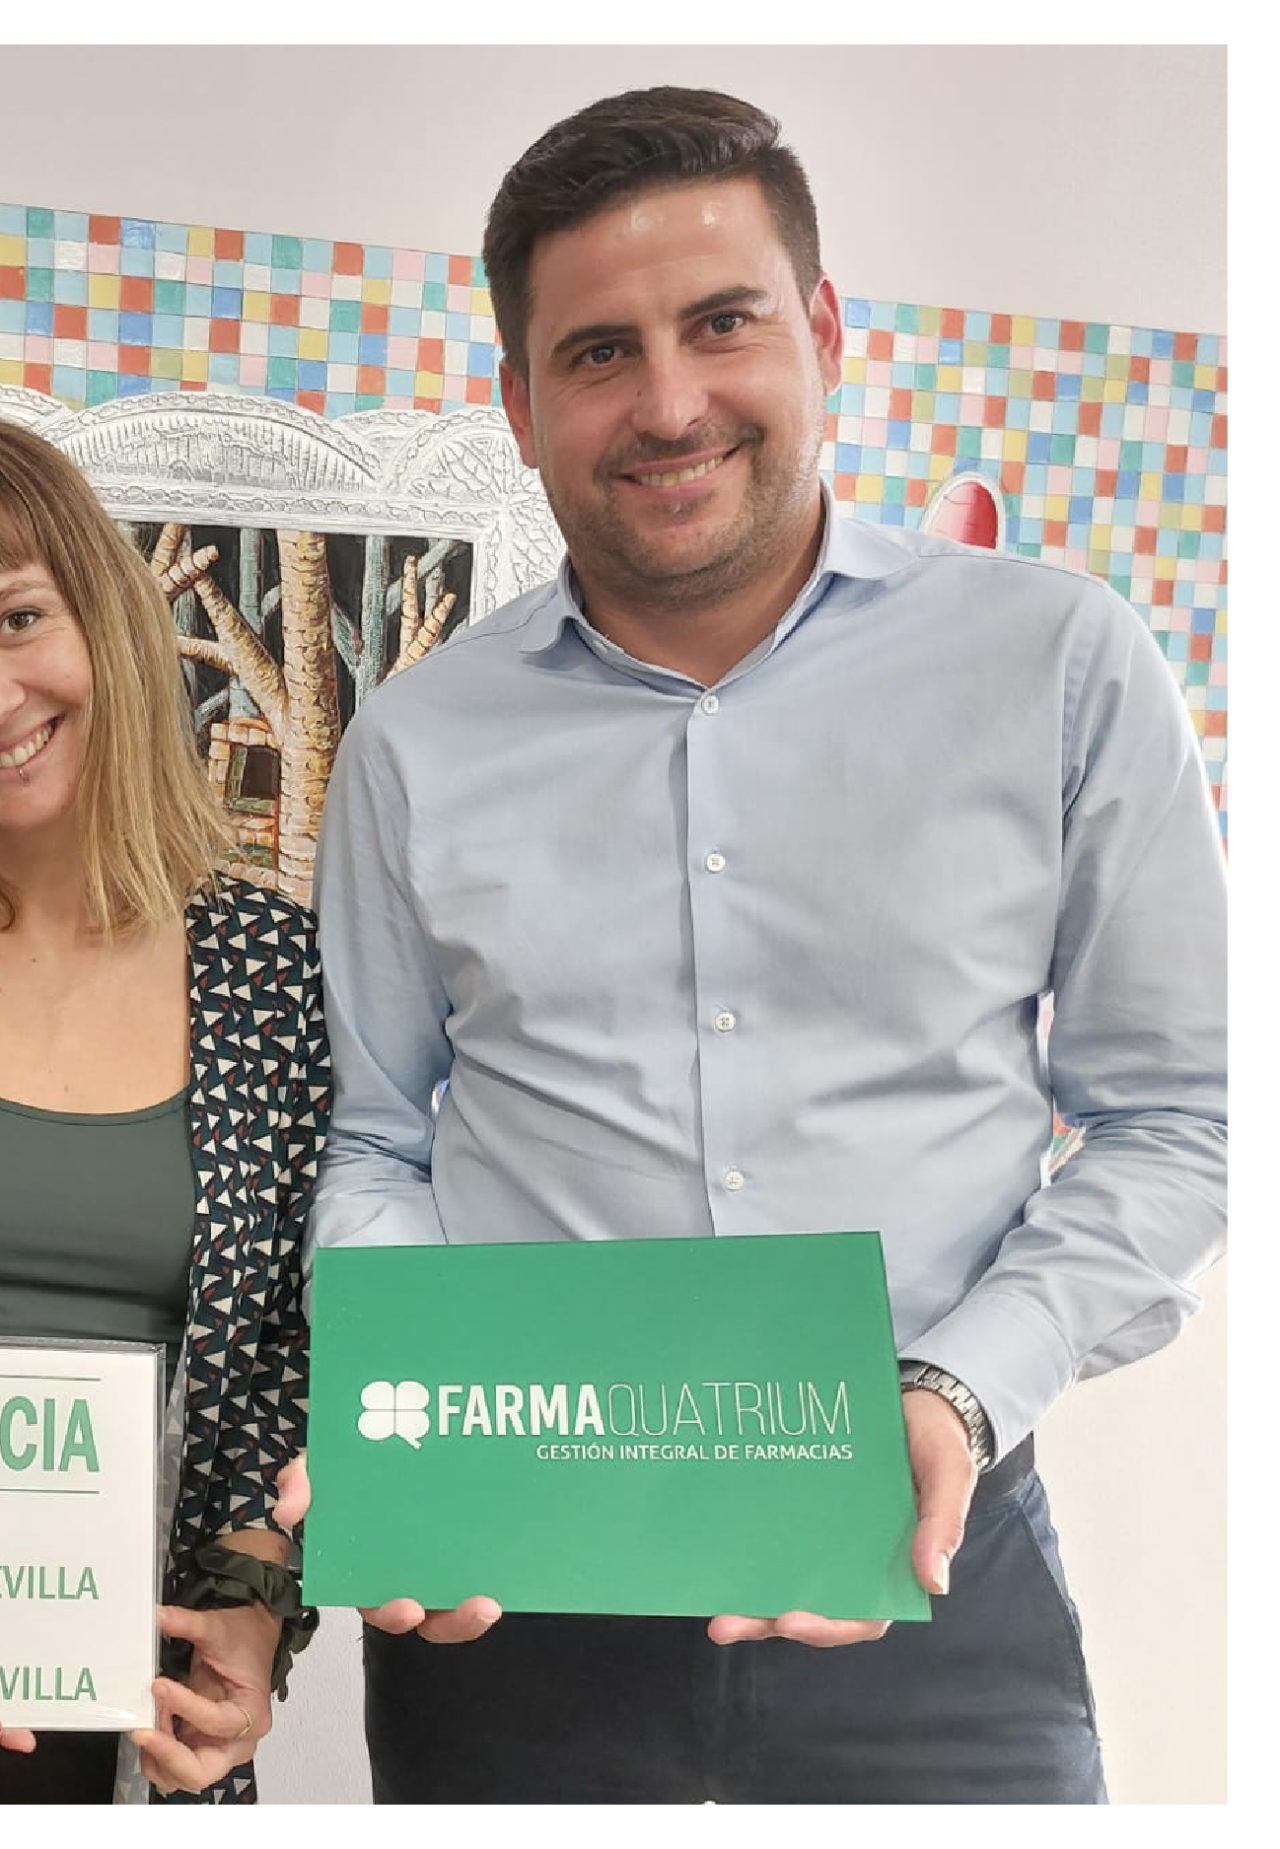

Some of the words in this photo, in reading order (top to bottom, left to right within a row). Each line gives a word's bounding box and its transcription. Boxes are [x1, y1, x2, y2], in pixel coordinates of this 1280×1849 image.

[439, 1381, 853, 1437] FARMAQUATRIUM
[536, 1442, 614, 1461] GESTIÓN
[620, 1444, 709, 1461] INTEGRAL
[714, 1445, 739, 1461] DE
[745, 1444, 853, 1461] FARMACIAS
